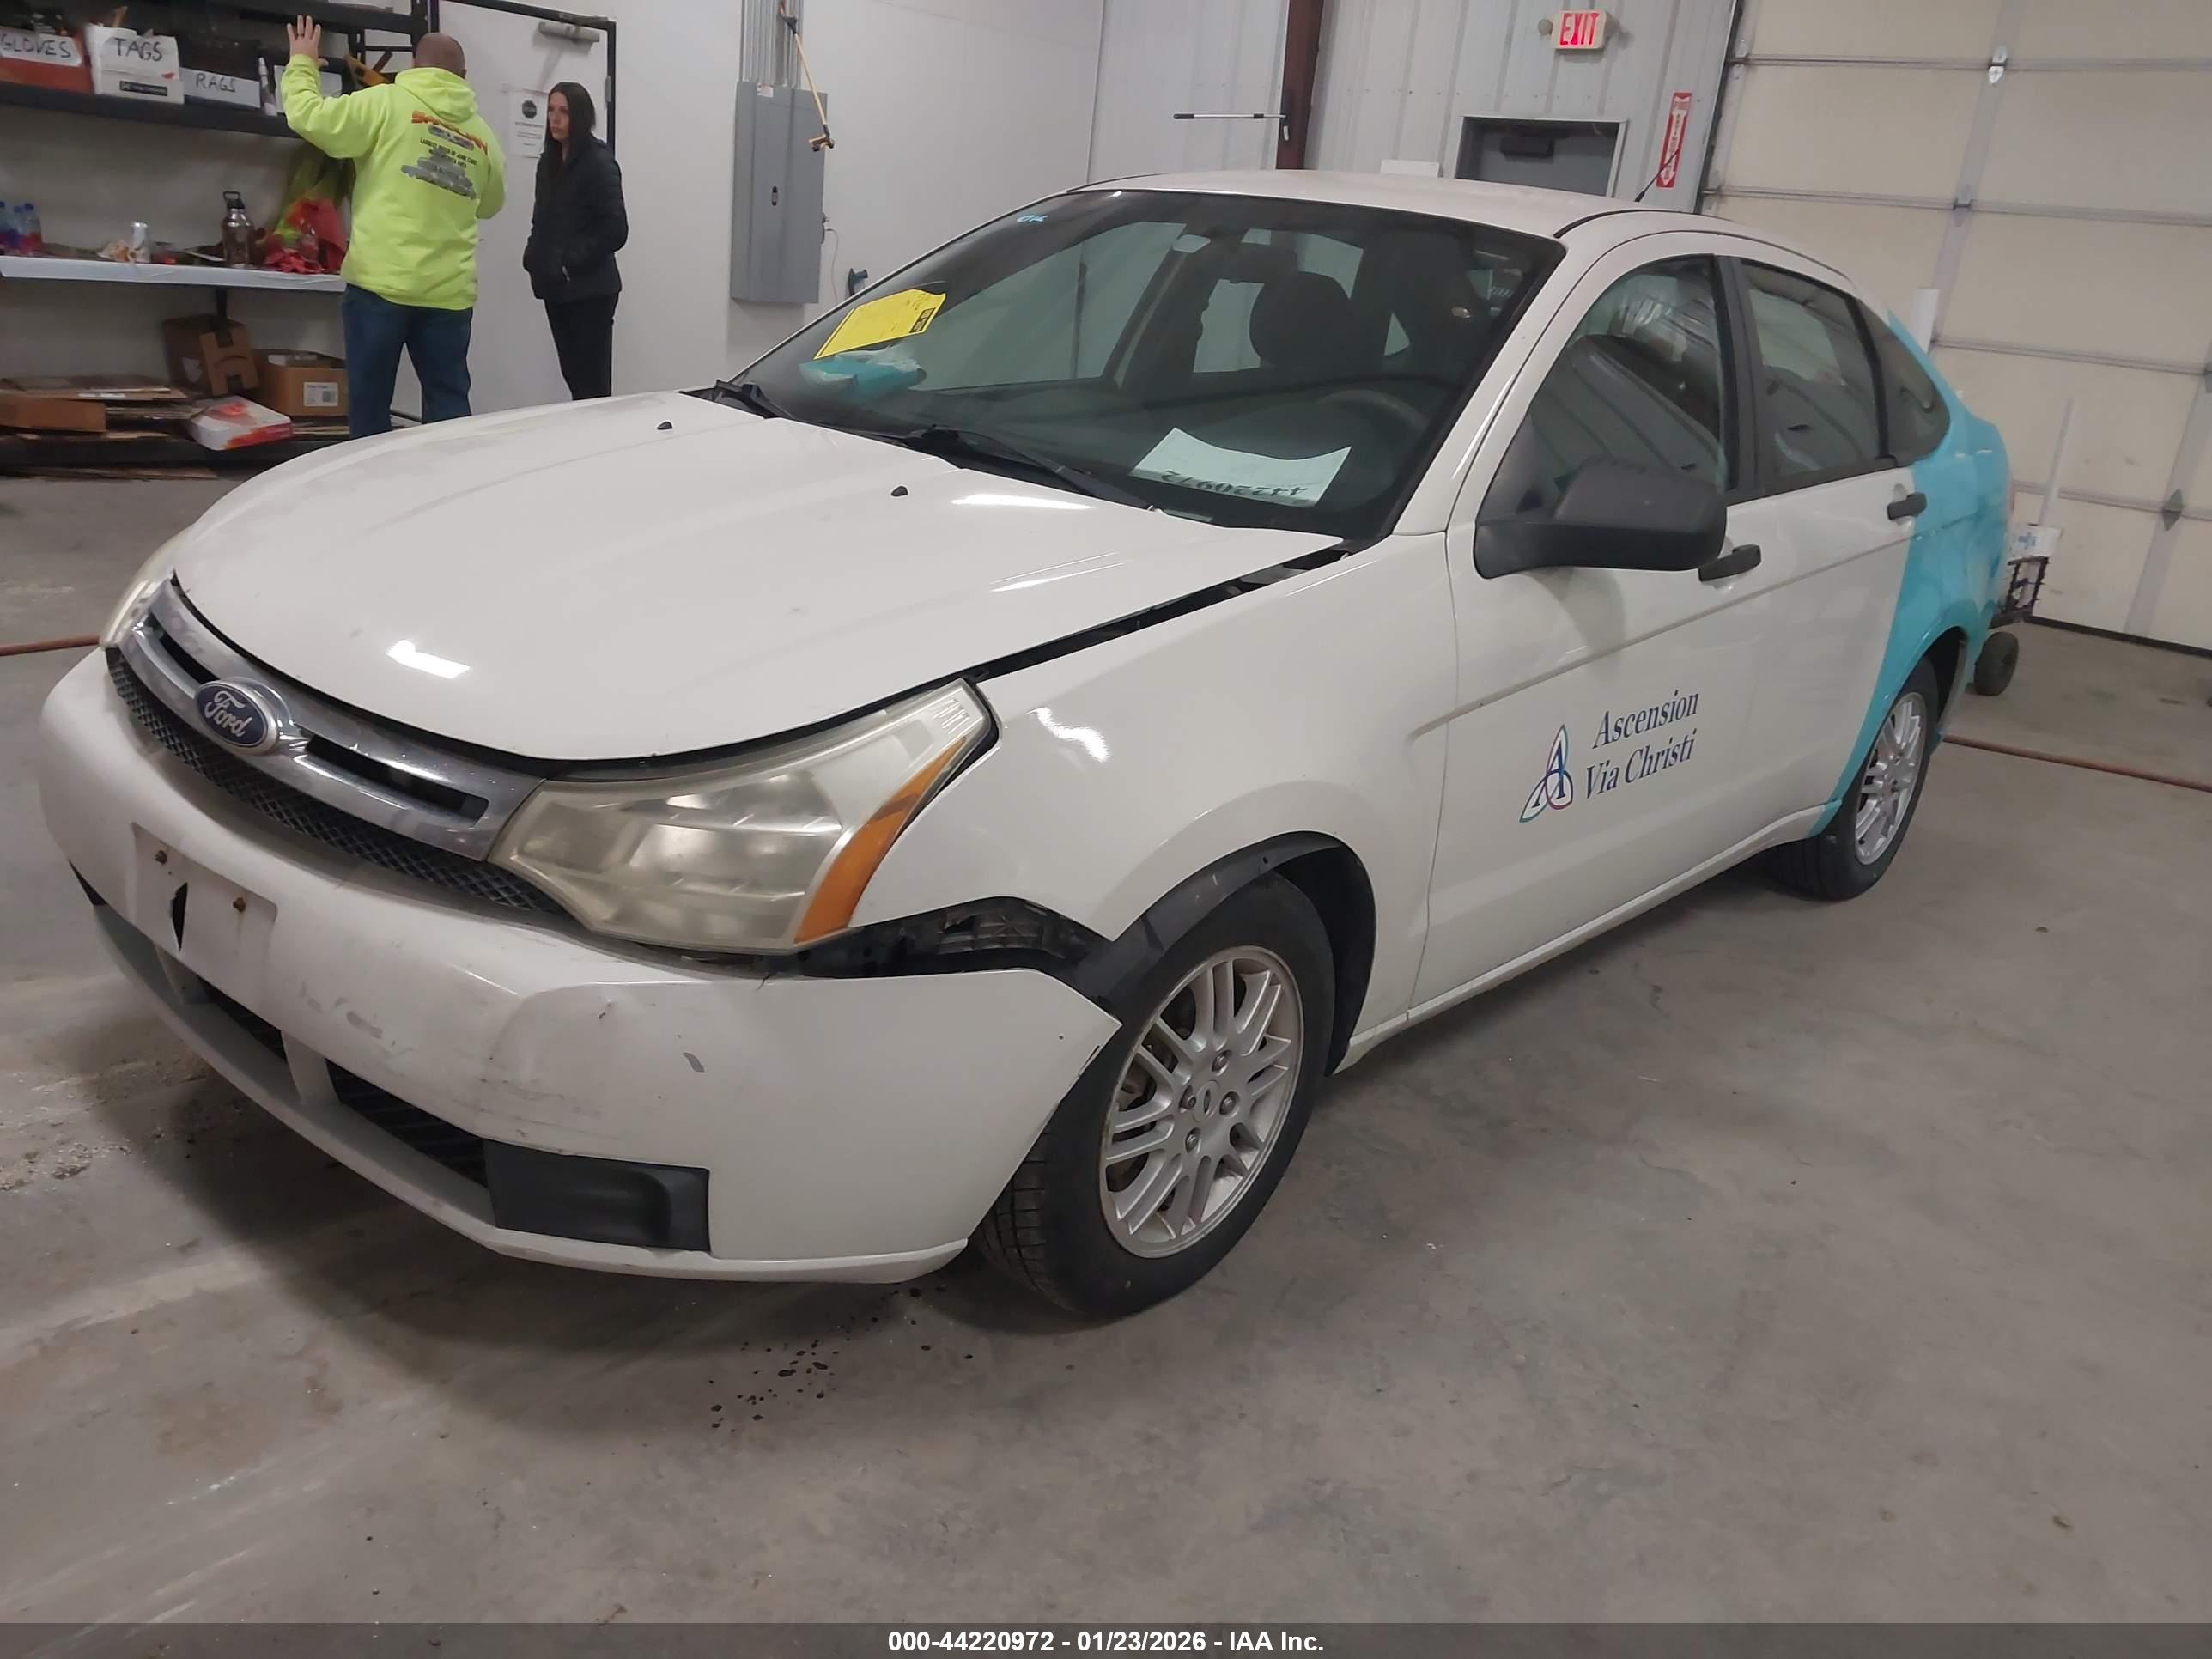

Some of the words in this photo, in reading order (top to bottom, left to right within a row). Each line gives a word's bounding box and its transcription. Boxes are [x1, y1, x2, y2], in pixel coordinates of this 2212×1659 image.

[1, 33, 71, 58] GLOVES
[1559, 12, 1600, 46] EXIT
[114, 37, 163, 62] TAGS
[195, 72, 236, 93] RAGS
[204, 690, 252, 738] Ford
[1592, 690, 1699, 749] Ascension
[1586, 760, 1620, 799] Via
[1625, 728, 1698, 783] Christi
